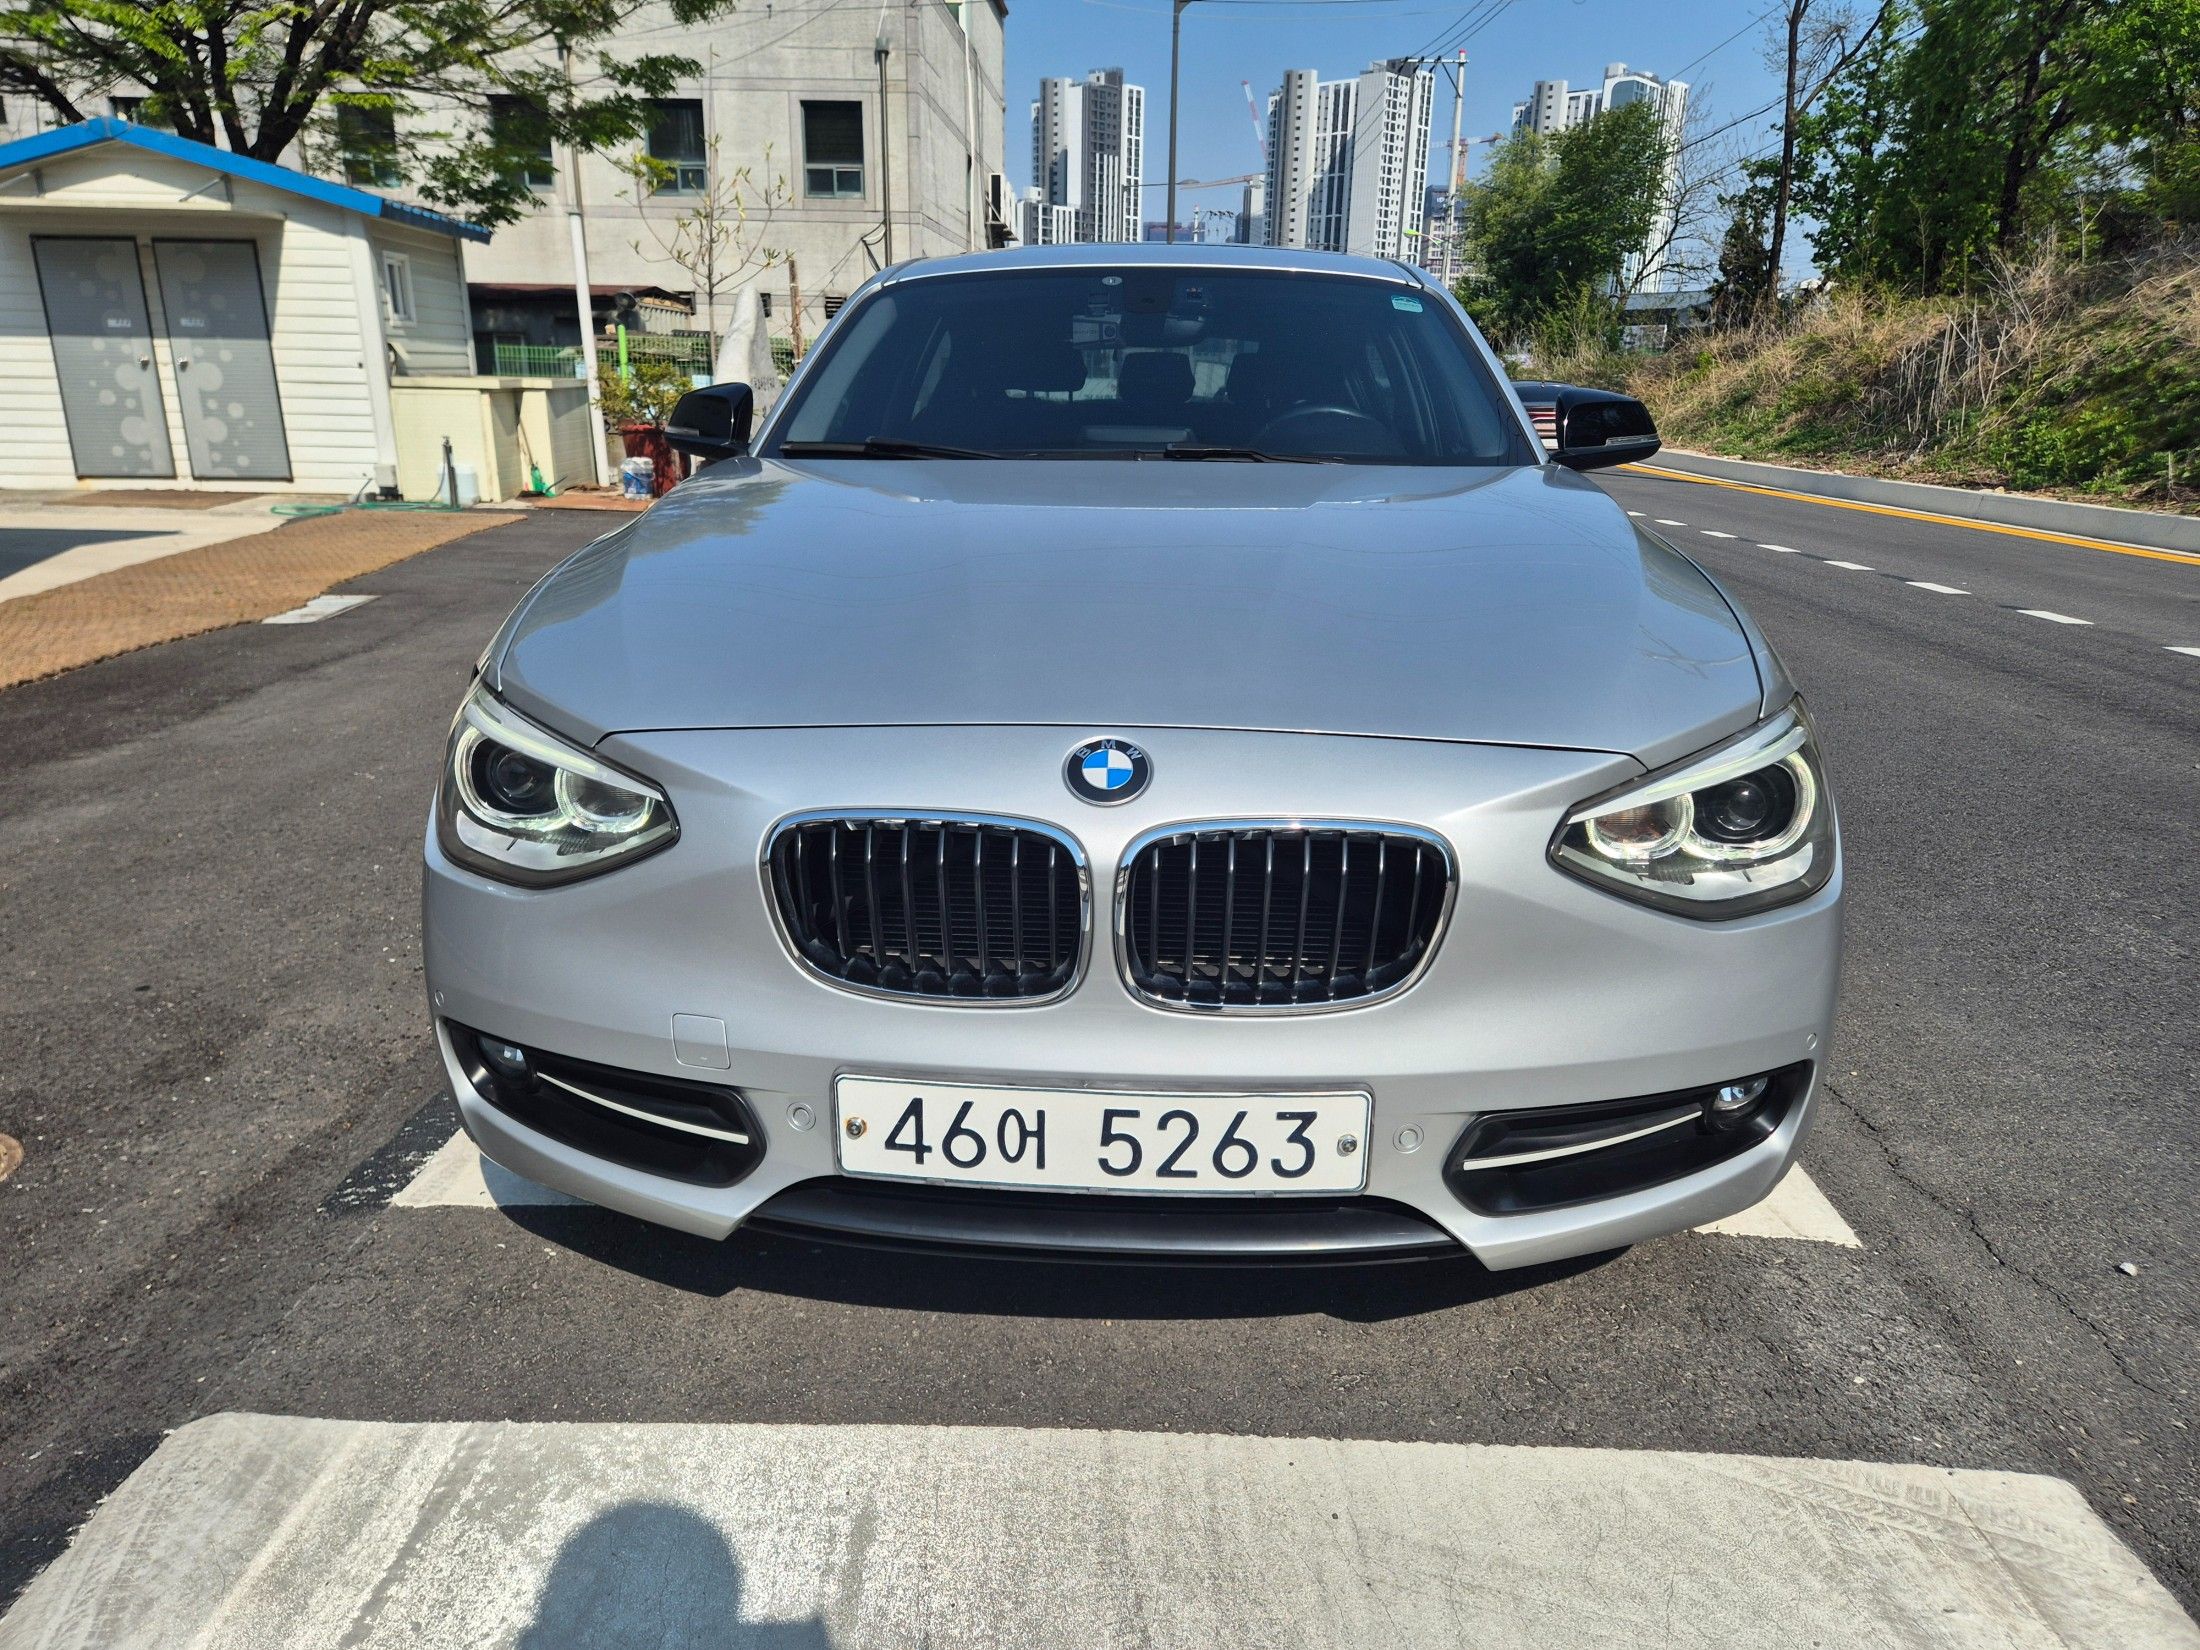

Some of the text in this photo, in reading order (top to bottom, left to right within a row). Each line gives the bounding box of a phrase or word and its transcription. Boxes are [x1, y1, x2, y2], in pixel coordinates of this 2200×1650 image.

[1075, 739, 1142, 760] BMW
[884, 1097, 1318, 1178] 46어 5263
